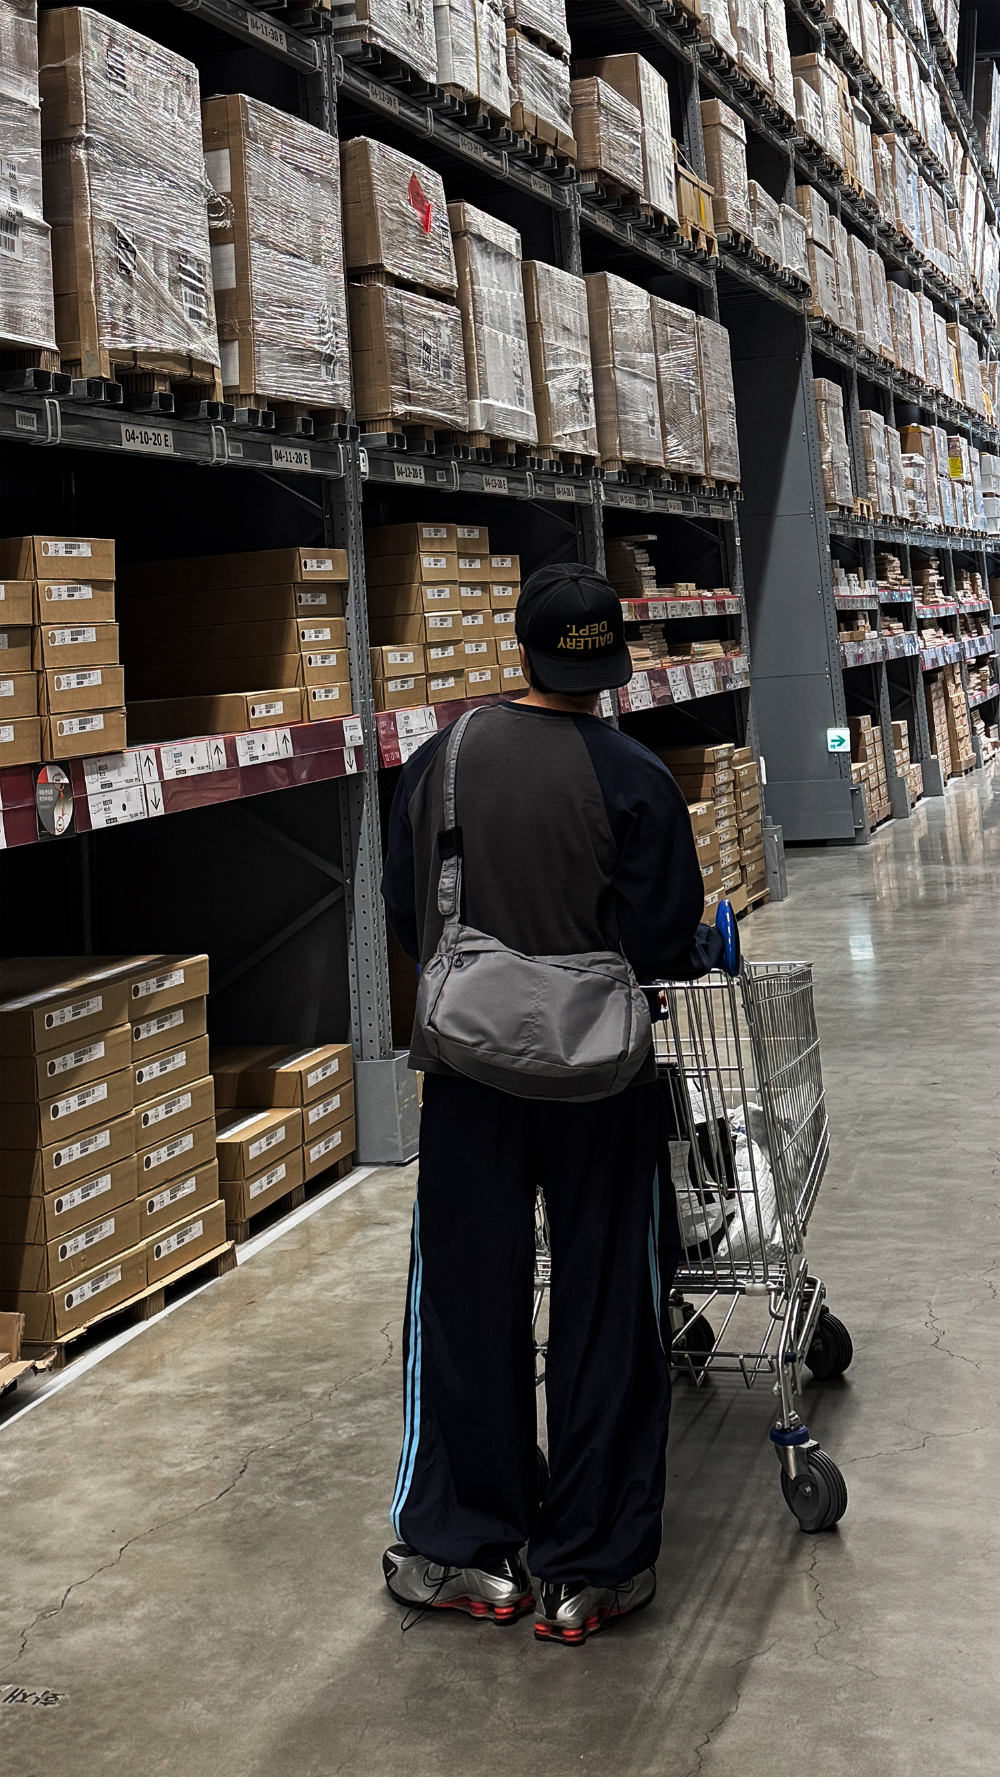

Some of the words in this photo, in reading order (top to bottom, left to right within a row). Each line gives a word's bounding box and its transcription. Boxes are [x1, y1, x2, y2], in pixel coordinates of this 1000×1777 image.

[250, 17, 278, 43] 04-11-30
[279, 31, 284, 46] E
[370, 85, 393, 107] 04-12-30
[125, 428, 162, 447] 04-10-20
[274, 449, 303, 465] 04-11-20
[303, 452, 308, 466] E
[396, 465, 419, 479] 04-12-20
[419, 468, 423, 479] E
[566, 620, 608, 636] DEPT.
[557, 631, 614, 650] GALLERY
